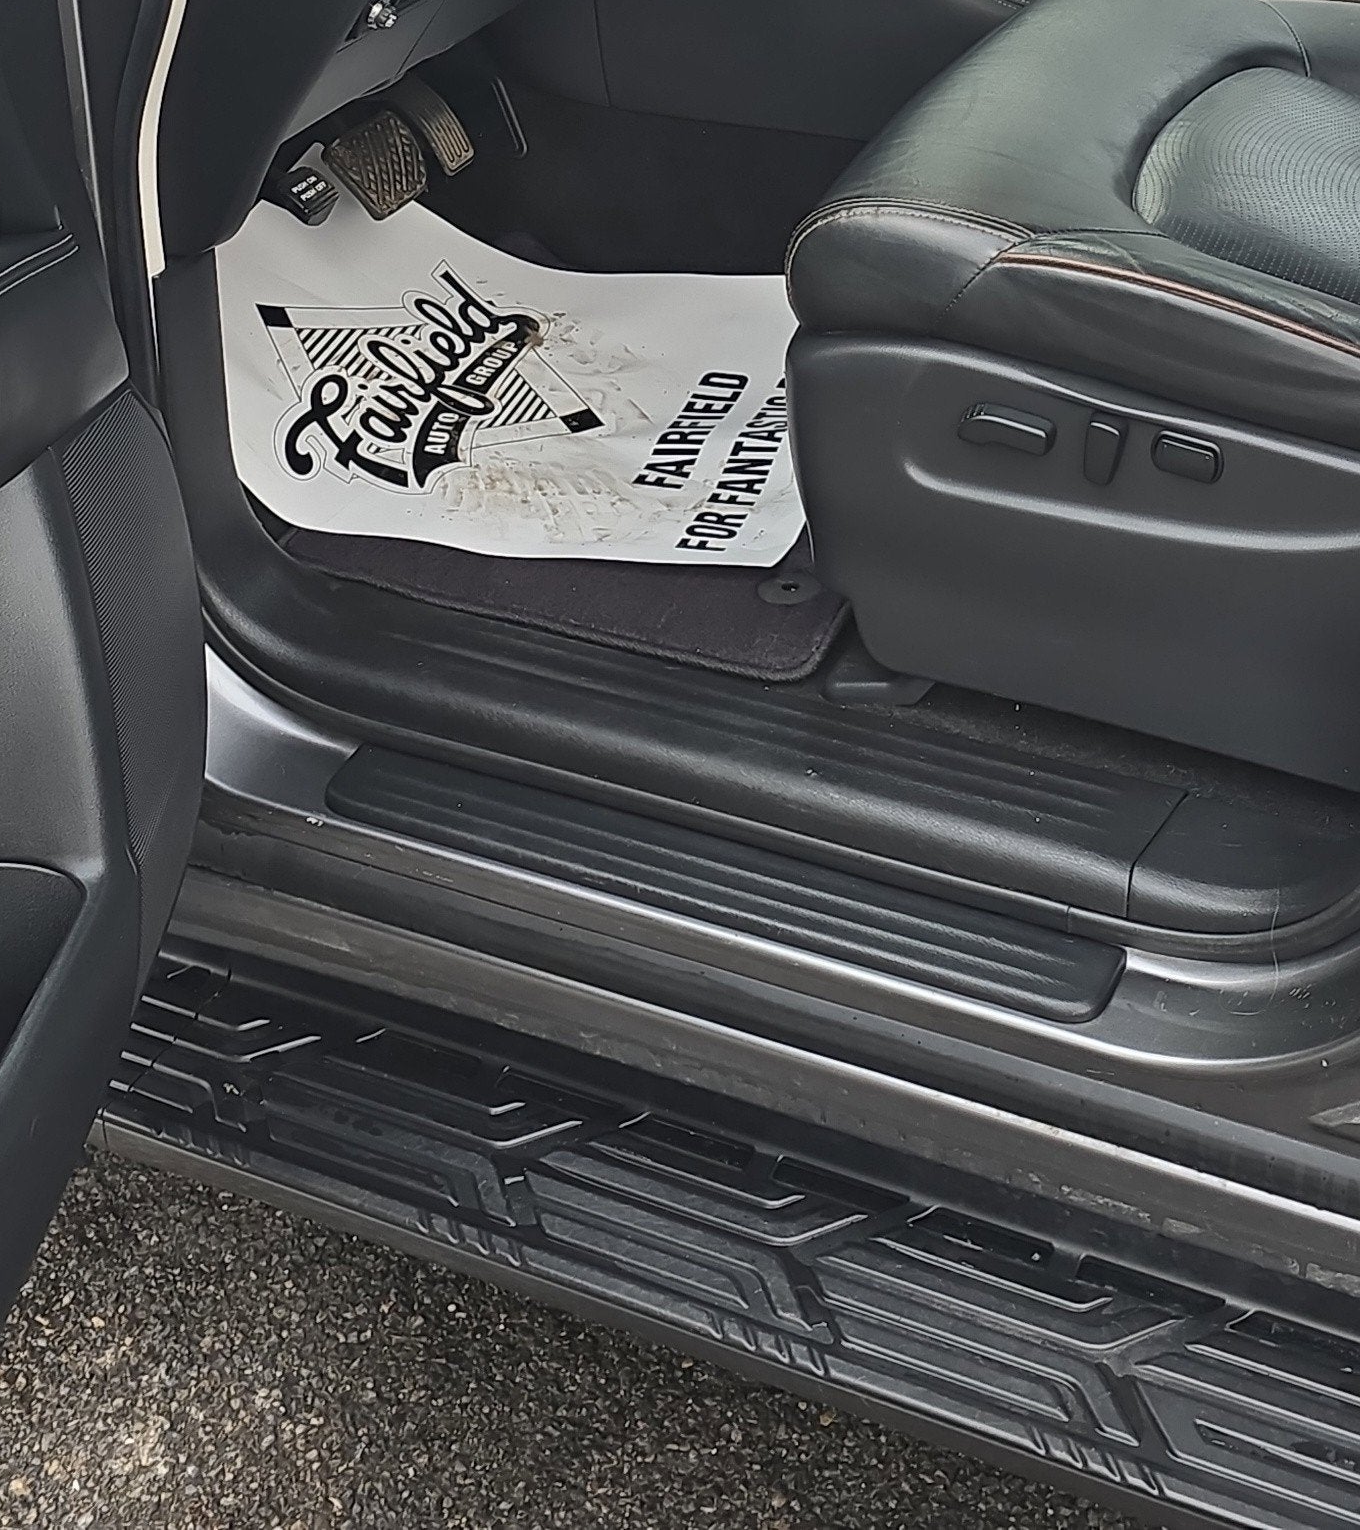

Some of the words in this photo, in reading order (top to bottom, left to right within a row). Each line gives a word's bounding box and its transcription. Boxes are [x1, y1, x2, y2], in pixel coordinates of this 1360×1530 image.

[291, 181, 309, 194] PUSH
[300, 188, 317, 201] PUSH
[315, 181, 327, 191] OFF
[424, 412, 460, 455] AUTO
[465, 341, 519, 386] GROUP
[632, 372, 749, 489] FAIRFIELD
[675, 511, 748, 551] FOR
